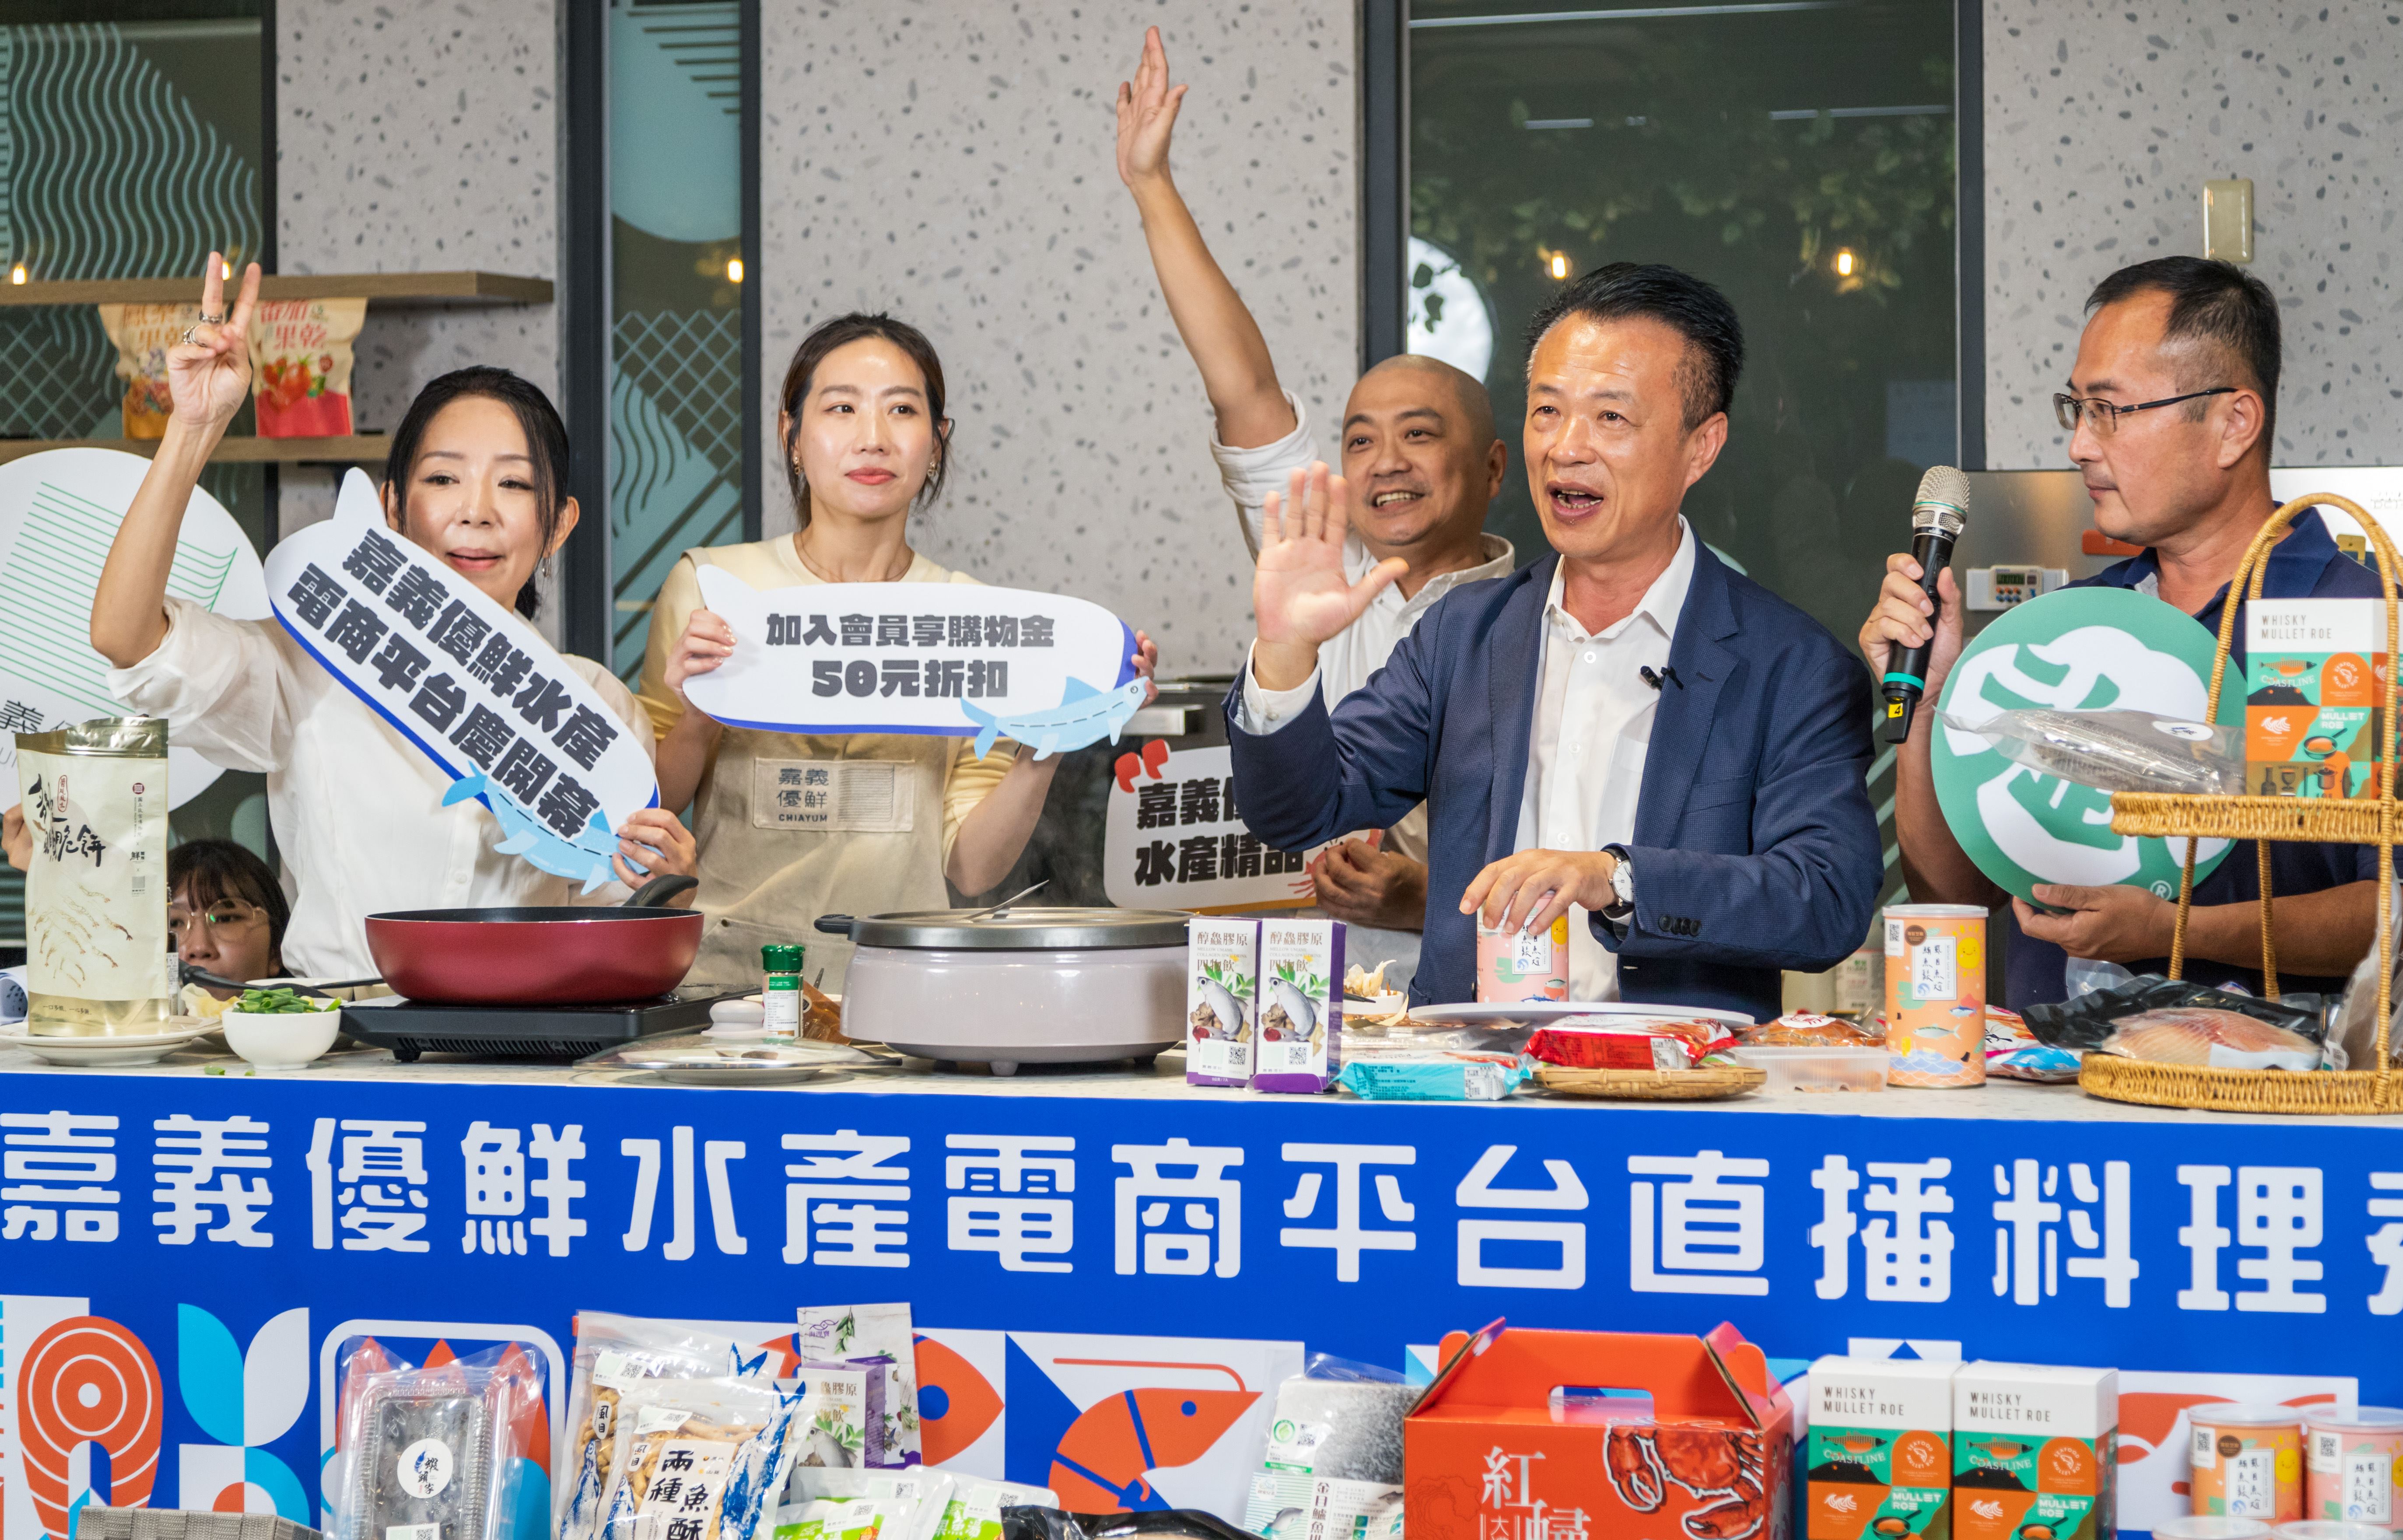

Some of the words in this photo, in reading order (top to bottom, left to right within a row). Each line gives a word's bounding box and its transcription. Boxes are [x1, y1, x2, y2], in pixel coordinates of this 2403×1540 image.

[2261, 615, 2307, 626] WHISKY
[766, 613, 1055, 648] 加入會員享購物金
[2261, 628, 2306, 639] MULLET
[2311, 628, 2332, 639] ROE
[343, 528, 618, 772] 嘉義優鮮水產
[2333, 662, 2358, 672] SEAFOOD
[812, 660, 1008, 698] 50元折扣
[2260, 675, 2315, 687] COASTLINE
[287, 563, 600, 839] 電商平台慶開幕
[1893, 702, 1902, 715] 4
[2321, 713, 2364, 721] MULLET
[778, 767, 829, 787] 嘉義
[777, 789, 828, 810] 優鮮
[778, 814, 828, 822] CHIAYUM
[1197, 931, 1248, 946] 醇鱻膠原
[1270, 931, 1323, 946] 醇鱻膠原
[1197, 959, 1235, 972] 四物飲
[1270, 959, 1308, 972] 四物飲
[1824, 1386, 1876, 1399] WHISKY
[1970, 1392, 2022, 1406] WHISKY
[1824, 1401, 1874, 1414] MULLET
[1881, 1403, 1905, 1416] ROE
[1970, 1407, 2021, 1421] MULLET
[2027, 1409, 2051, 1422] ROE
[1907, 1440, 1933, 1452] SEAFOOD
[1823, 1449, 1886, 1464] COASTLINE
[2054, 1447, 2080, 1459] SEAFOOD
[1969, 1454, 2032, 1470] COASTLINE
[1892, 1492, 1941, 1502] MULLET
[1892, 1502, 1918, 1511] ROE
[2039, 1499, 2088, 1510] MULLET
[2039, 1509, 2065, 1518] ROE
